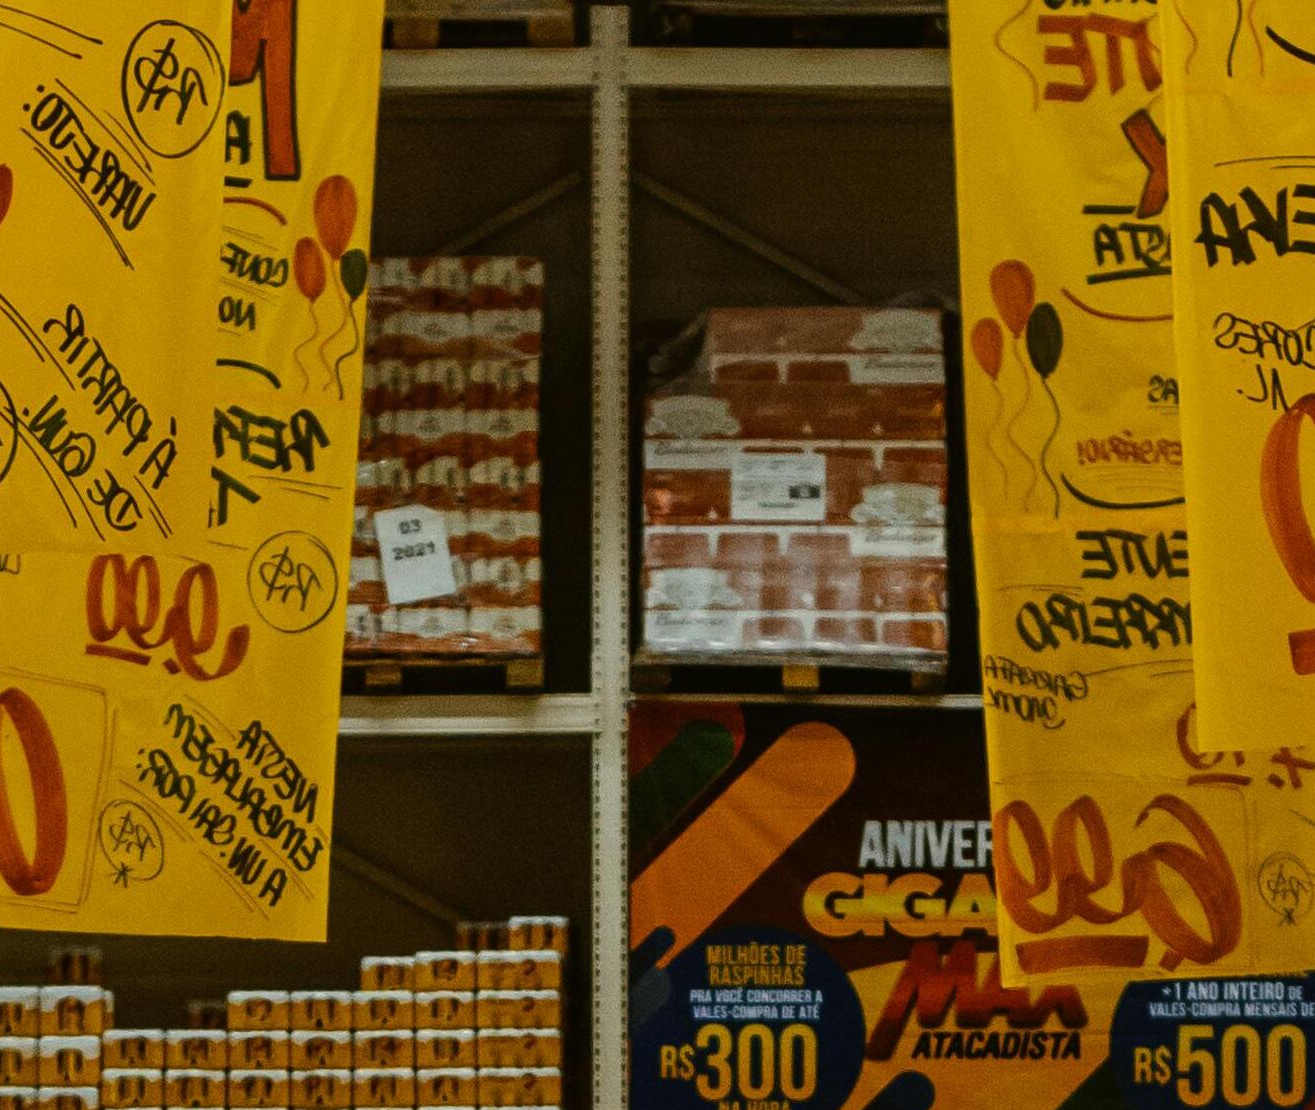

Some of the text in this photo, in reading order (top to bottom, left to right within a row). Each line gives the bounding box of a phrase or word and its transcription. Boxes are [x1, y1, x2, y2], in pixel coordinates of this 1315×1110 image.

[859, 820, 994, 869] ANIVER
[803, 871, 998, 938] GIGA
[706, 940, 807, 966] MILHÕES DE
[709, 964, 806, 986] RASPINHAS
[690, 989, 712, 1003] PRA
[1187, 981, 1219, 1001] ANO
[1223, 980, 1284, 1001] INTEIRO
[1288, 985, 1304, 1001] DE
[692, 1002, 821, 1019] VALES-COMPRA DE ATÉ
[1148, 1001, 1241, 1018] VALES-COMPRA
[1244, 1001, 1298, 1017] MENSAIS
[911, 1030, 1083, 1061] ATACADISTA
